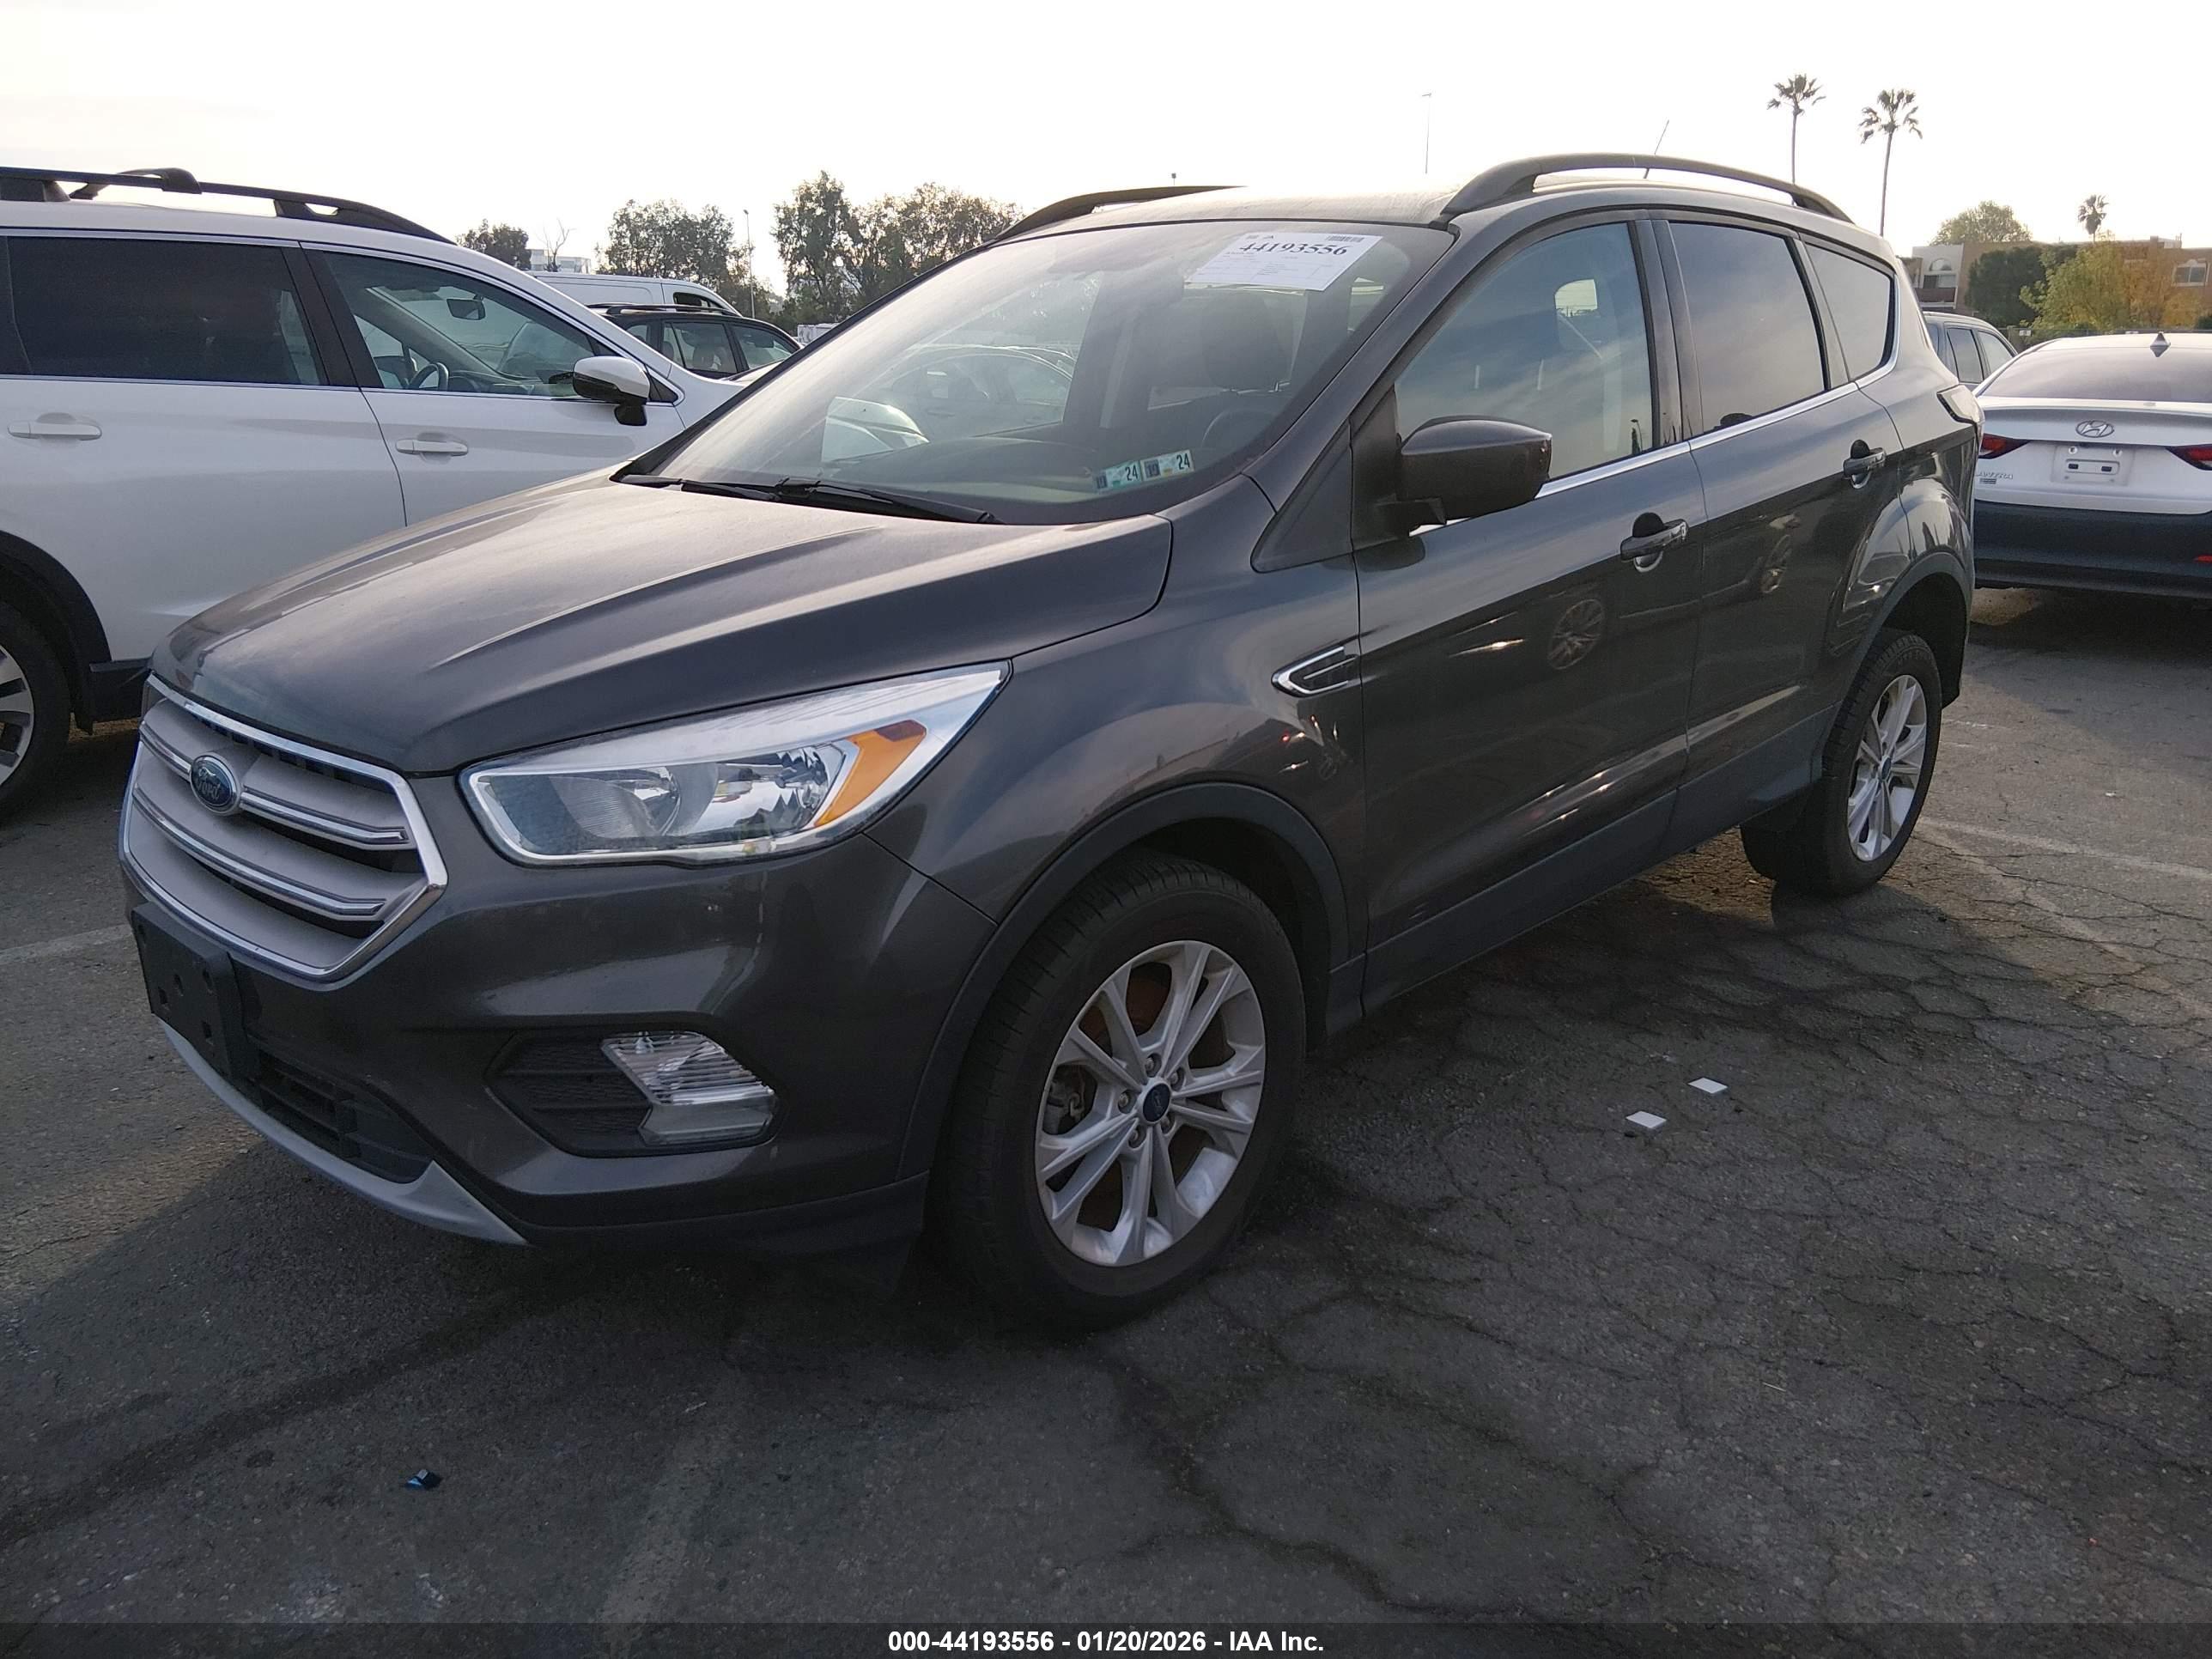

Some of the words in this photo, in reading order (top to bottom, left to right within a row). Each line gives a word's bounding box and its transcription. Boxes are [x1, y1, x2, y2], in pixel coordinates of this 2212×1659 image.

[1239, 241, 1351, 257] 44193556
[1176, 453, 1191, 471] 24
[1125, 465, 1139, 482] 24
